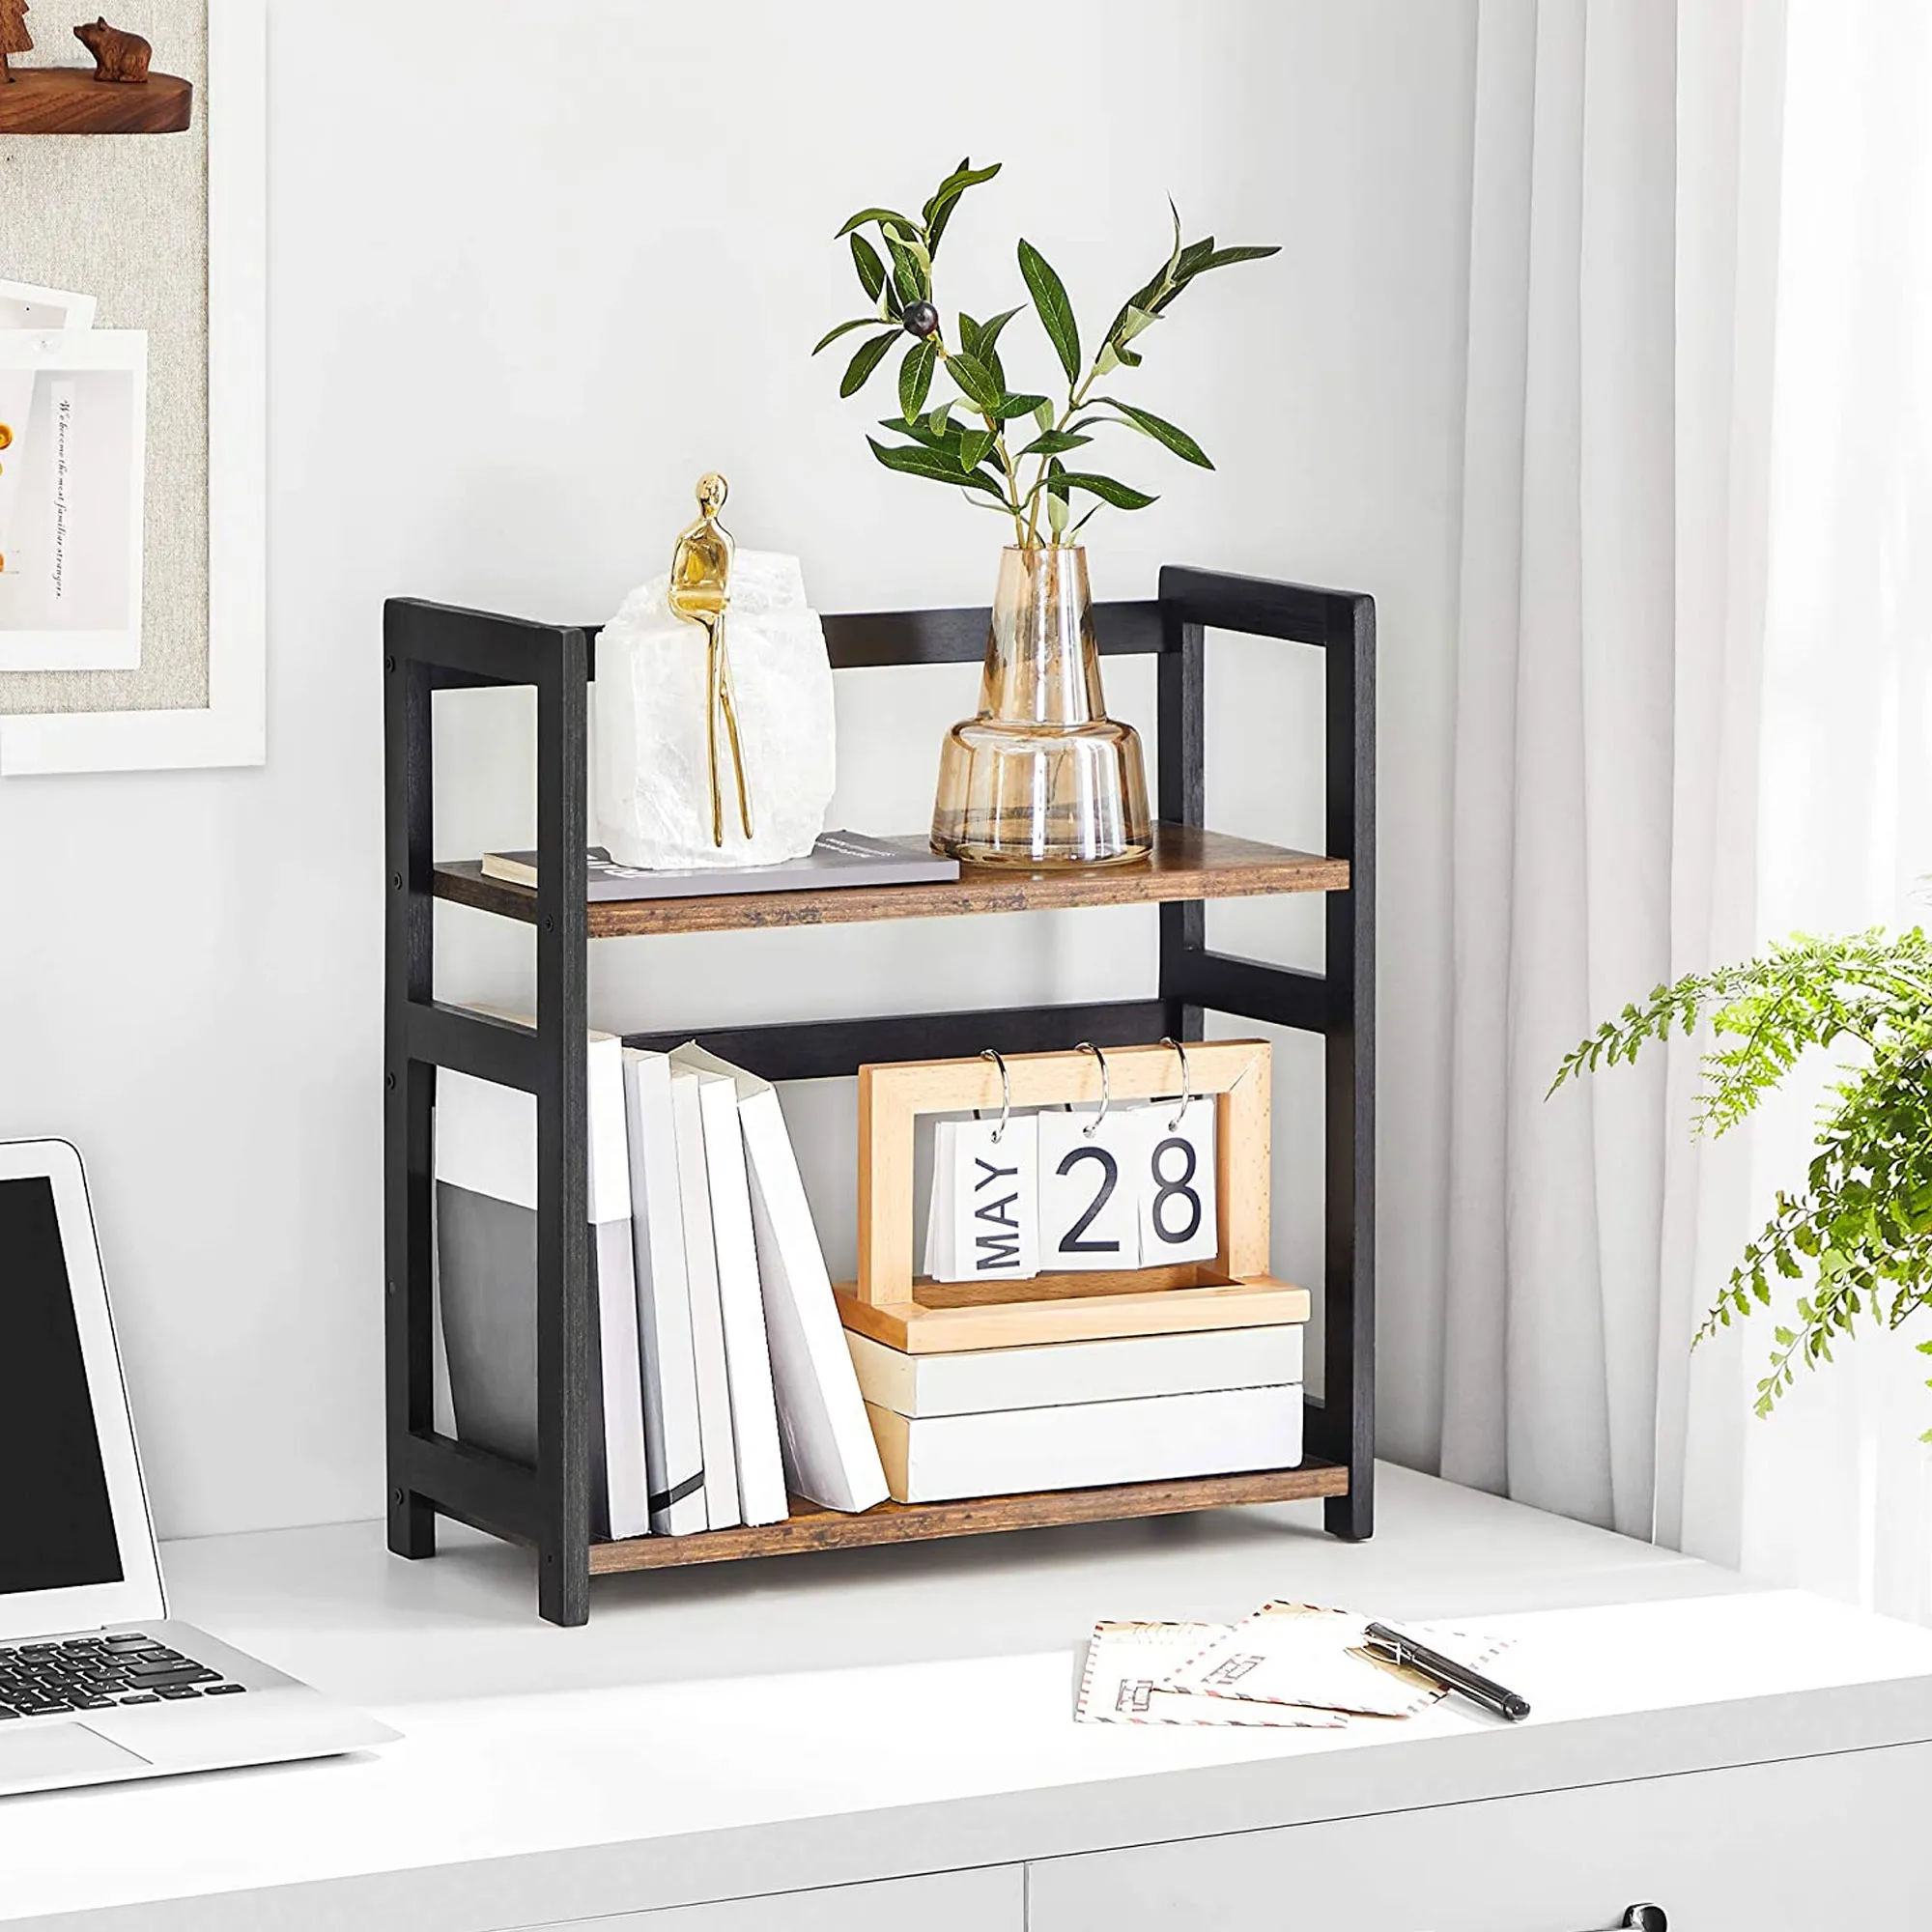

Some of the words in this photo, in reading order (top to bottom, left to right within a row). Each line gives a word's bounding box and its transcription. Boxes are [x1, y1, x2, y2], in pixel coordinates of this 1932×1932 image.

[58, 460, 69, 476] the
[53, 500, 68, 546] familiar
[975, 1157, 1020, 1270] MAY
